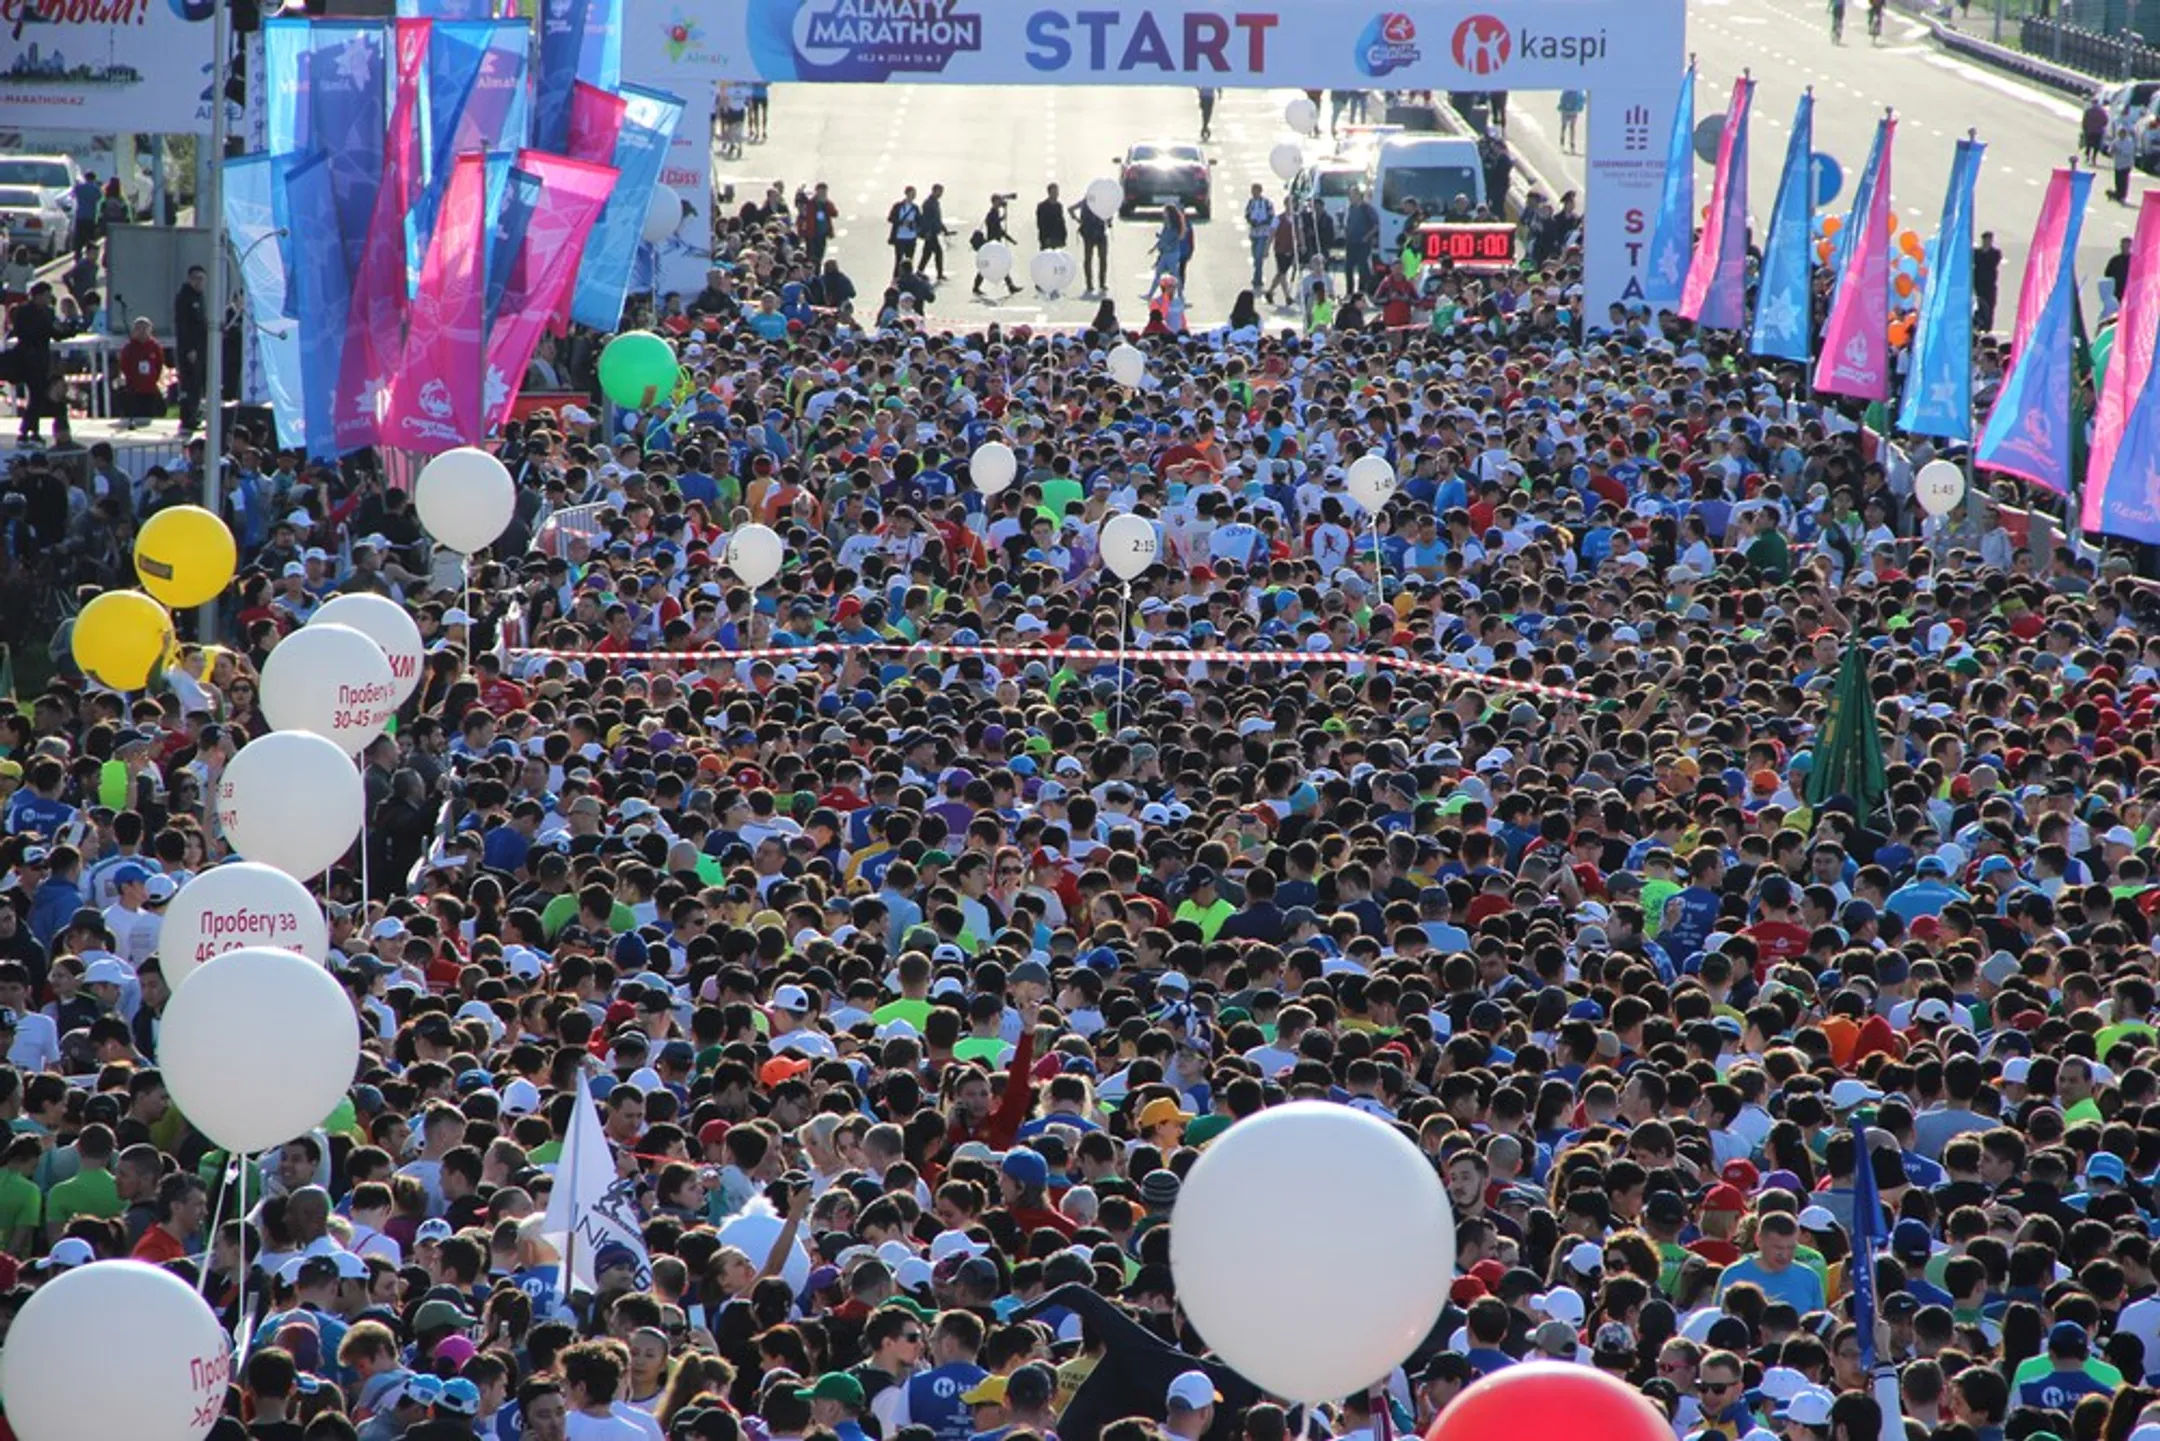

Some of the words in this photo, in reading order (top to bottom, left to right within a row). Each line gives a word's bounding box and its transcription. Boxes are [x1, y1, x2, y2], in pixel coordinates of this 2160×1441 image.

[813, 21, 976, 45] MARATHON
[1025, 9, 1279, 73] START
[1519, 28, 1606, 66] kaspi
[1427, 233, 1508, 256] 0:00:00
[1131, 538, 1154, 553] 2:15
[333, 709, 370, 729] 30-45
[200, 906, 276, 939] Пробегу
[279, 912, 298, 932] за
